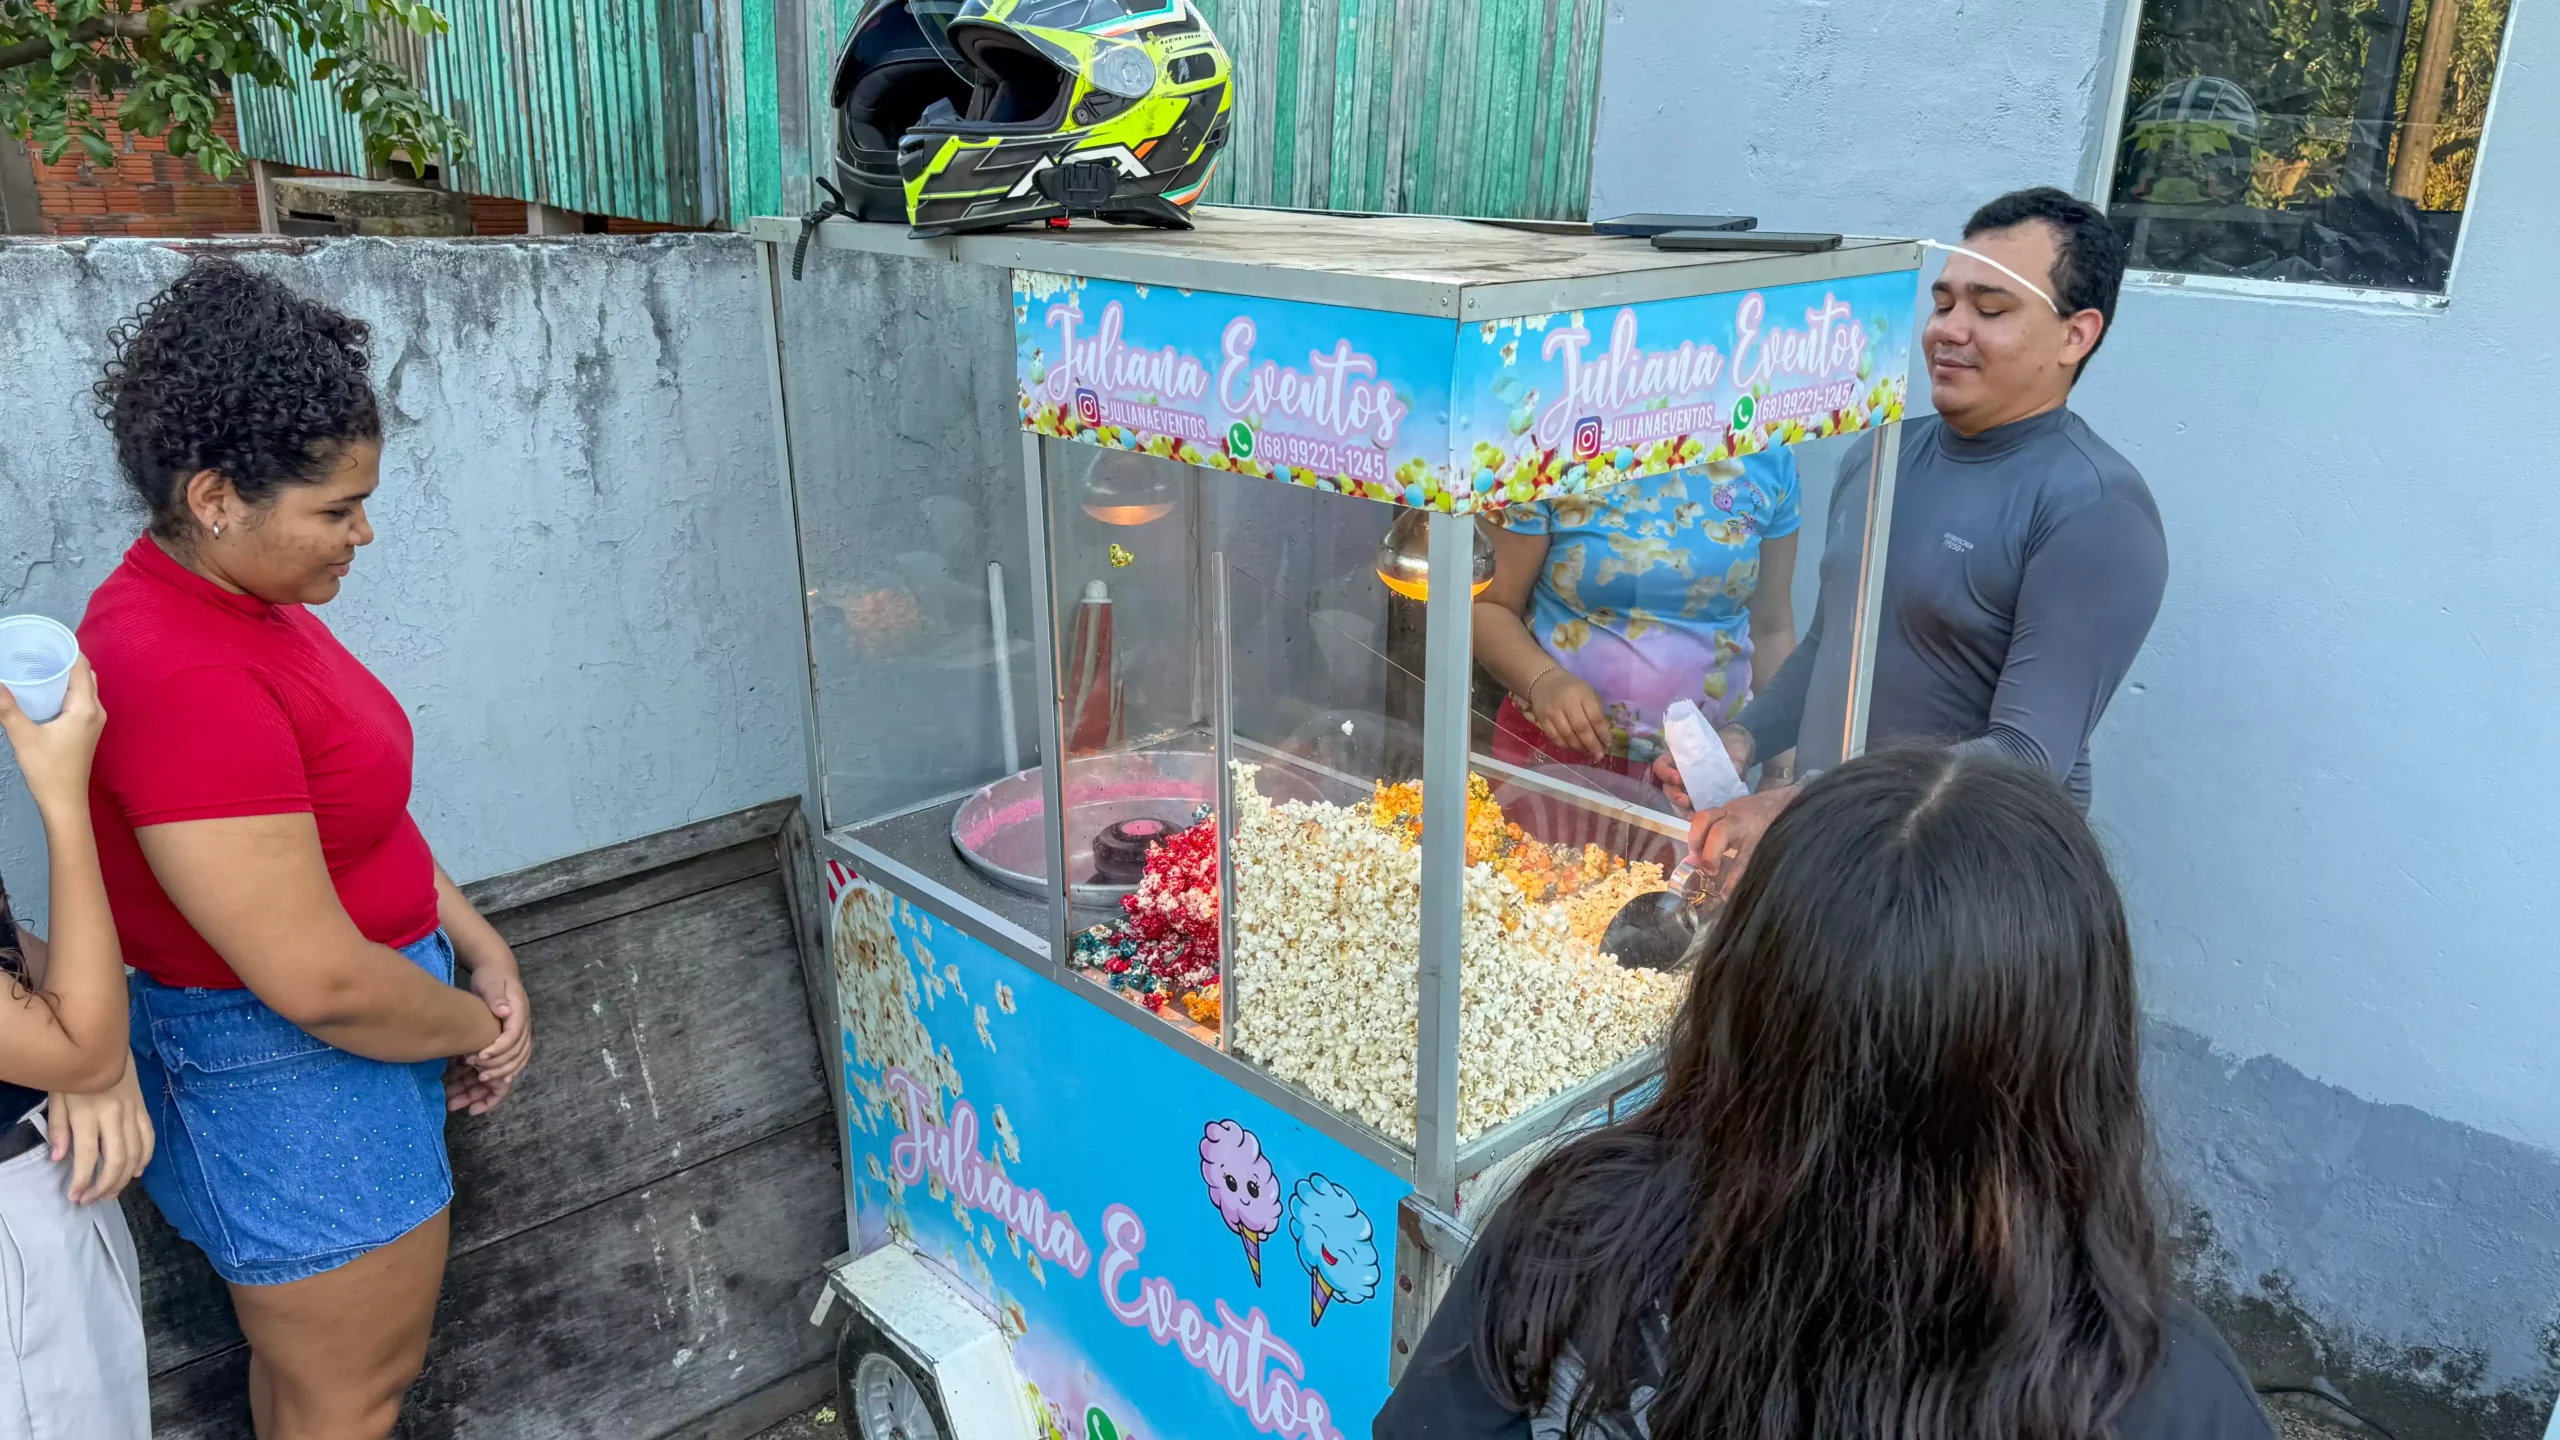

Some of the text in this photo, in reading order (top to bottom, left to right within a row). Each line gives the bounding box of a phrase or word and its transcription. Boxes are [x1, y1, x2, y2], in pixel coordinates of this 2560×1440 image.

[1047, 302, 1400, 441] Juliana Eventos
[1542, 297, 1865, 443] Juliana Eventos
[1757, 383, 1851, 420] (68)99221-1245
[1258, 433, 1384, 480] (68)99221-1245
[889, 1071, 1087, 1273] Juliana
